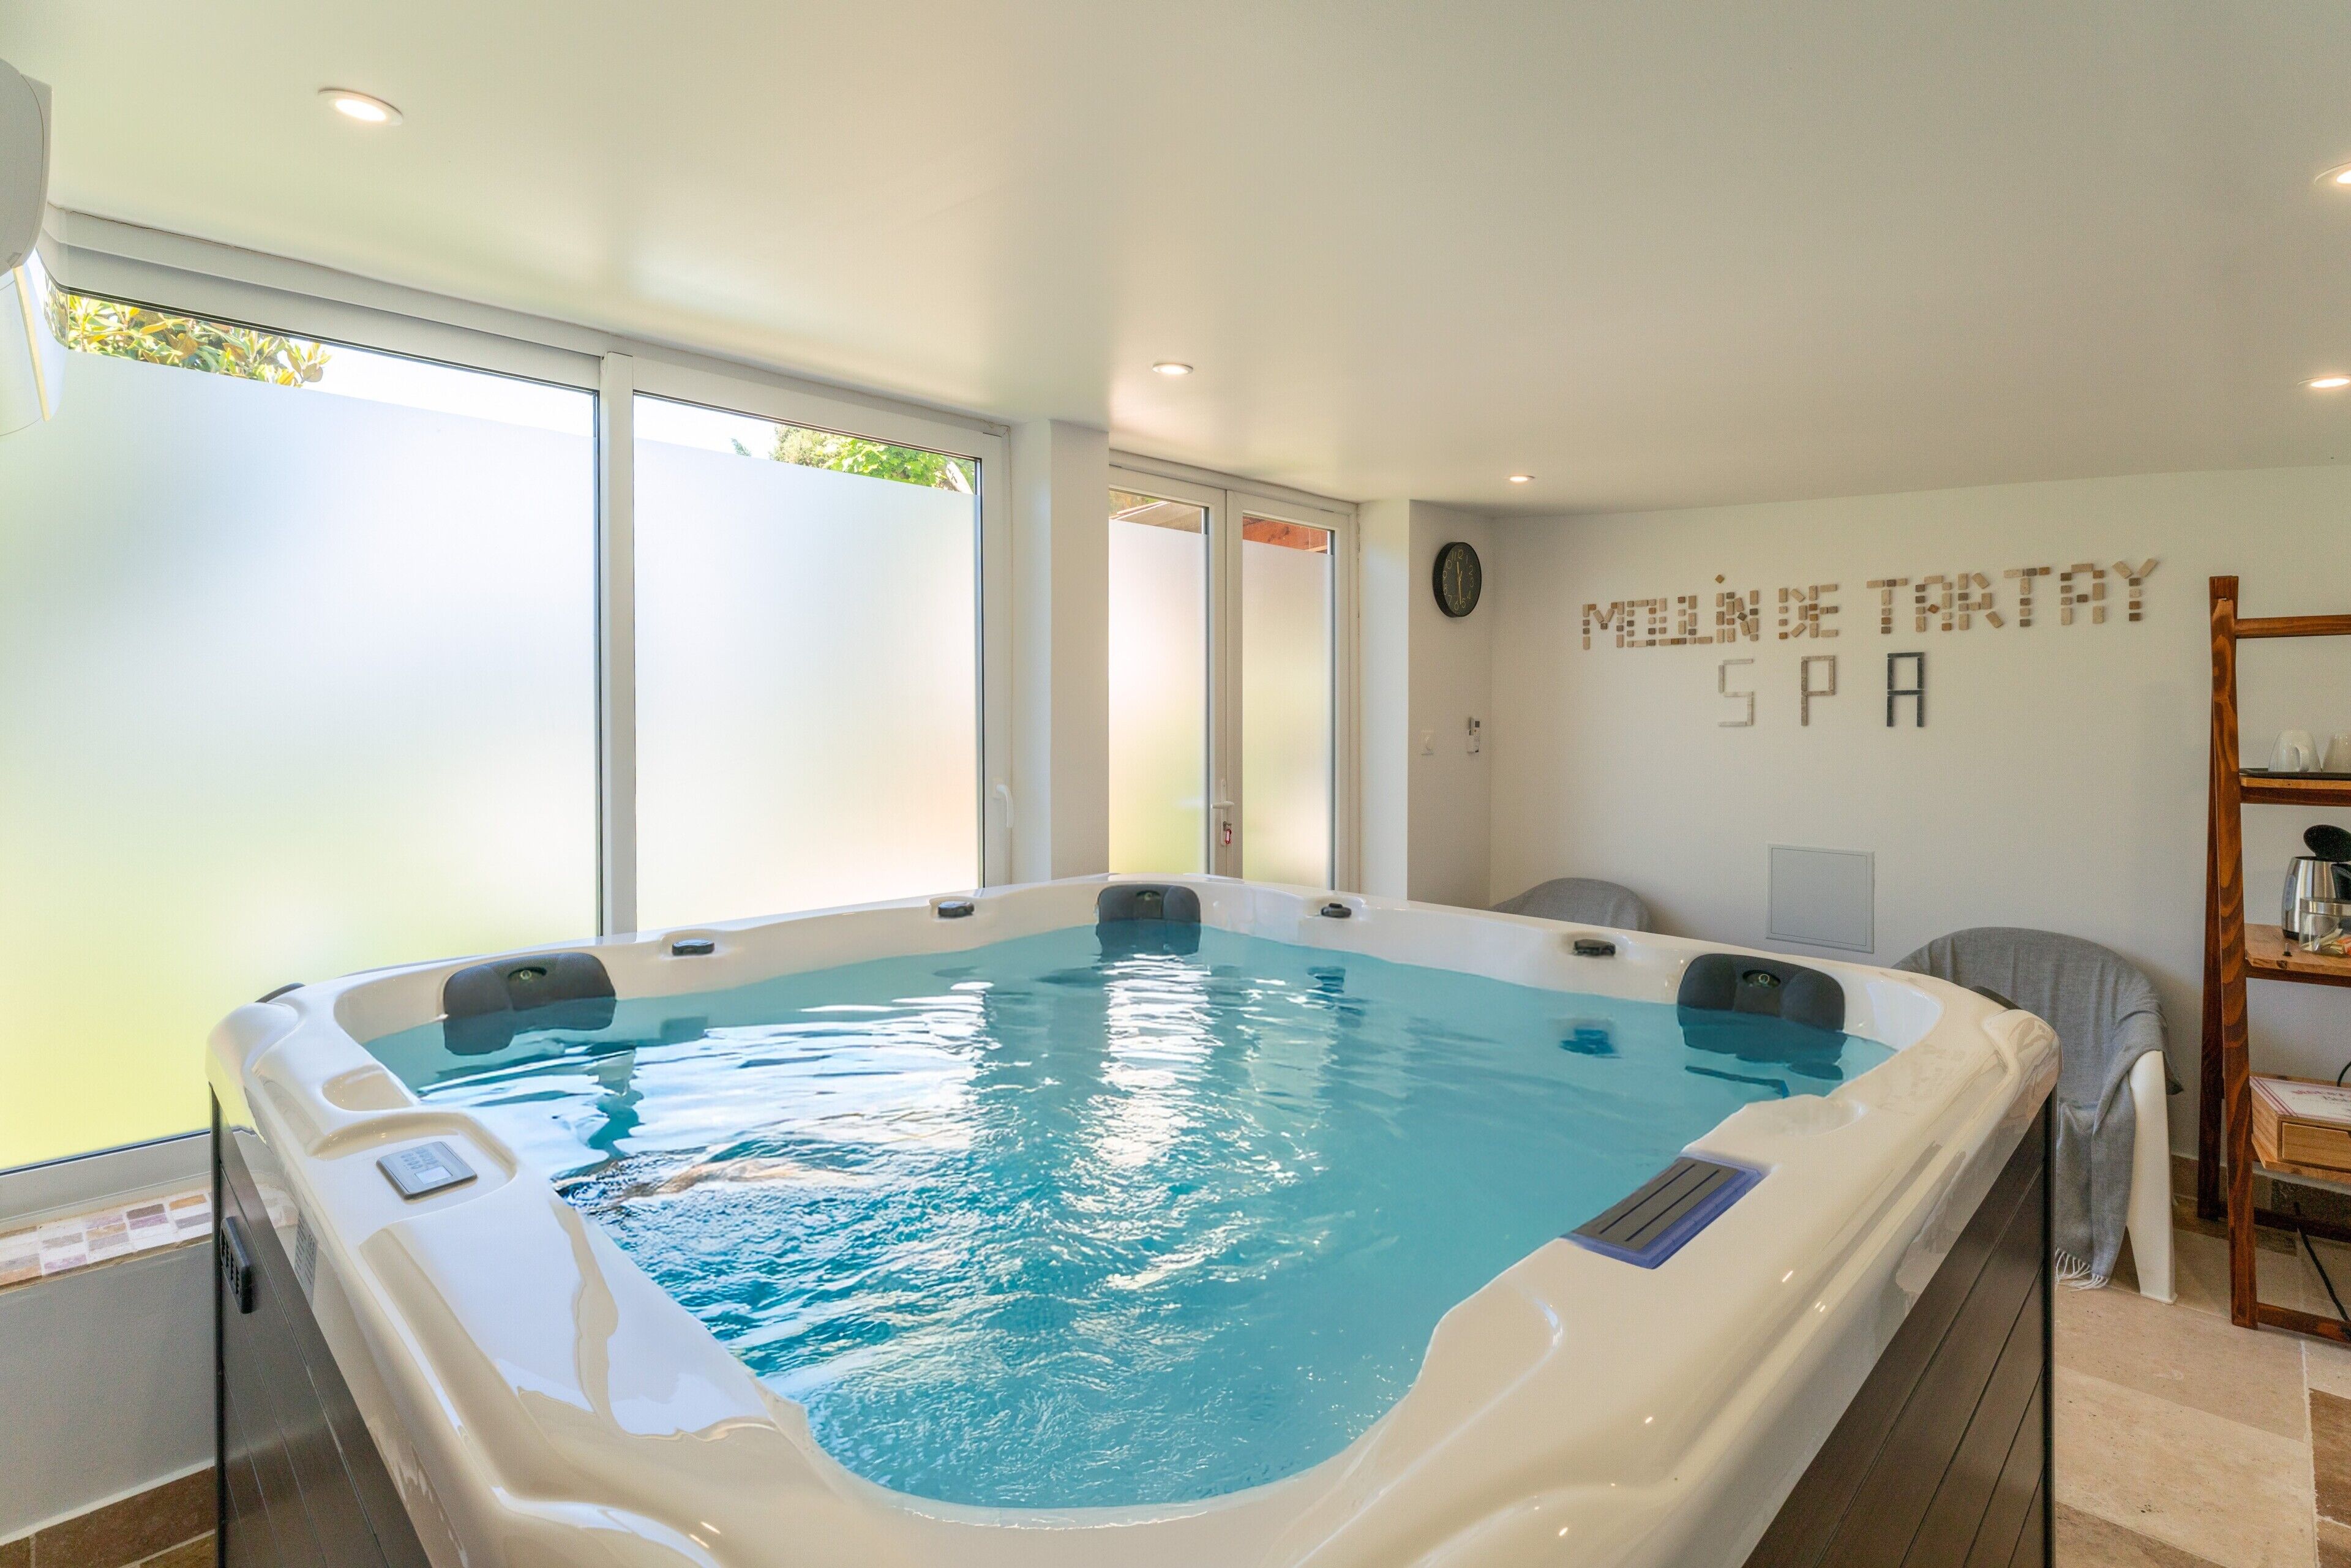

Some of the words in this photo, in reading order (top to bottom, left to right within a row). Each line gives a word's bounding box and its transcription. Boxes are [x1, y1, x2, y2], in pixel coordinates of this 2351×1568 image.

[1442, 570, 1447, 582] 9
[1469, 565, 1473, 576] 2
[1454, 599, 1458, 611] 6
[1778, 583, 1838, 640] DE
[1866, 558, 2158, 635] TARTAY
[1717, 651, 1924, 727] SPA
